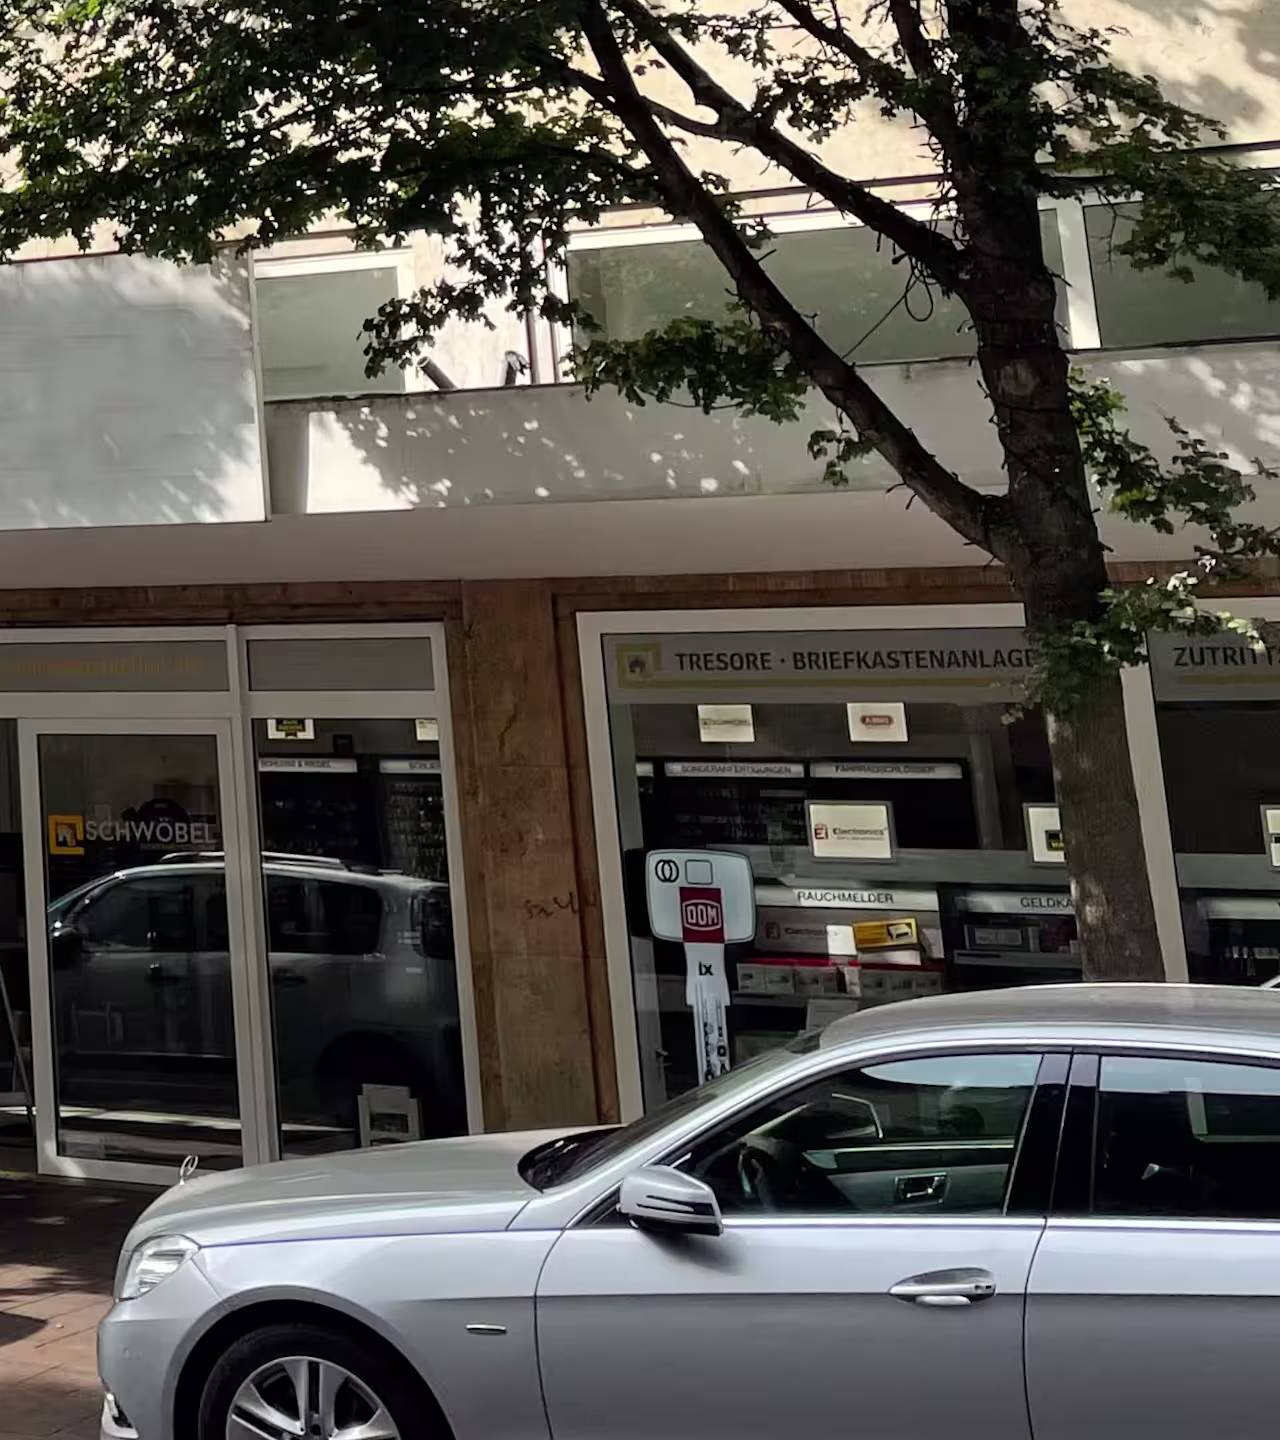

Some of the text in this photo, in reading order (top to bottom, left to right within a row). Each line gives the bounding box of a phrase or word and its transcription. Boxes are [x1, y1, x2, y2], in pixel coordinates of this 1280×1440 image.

[673, 647, 772, 672] TRESORE
[85, 817, 216, 844] SCHWÖBEL
[797, 891, 894, 905] RAUCHMELDER
[686, 904, 719, 926] DOM
